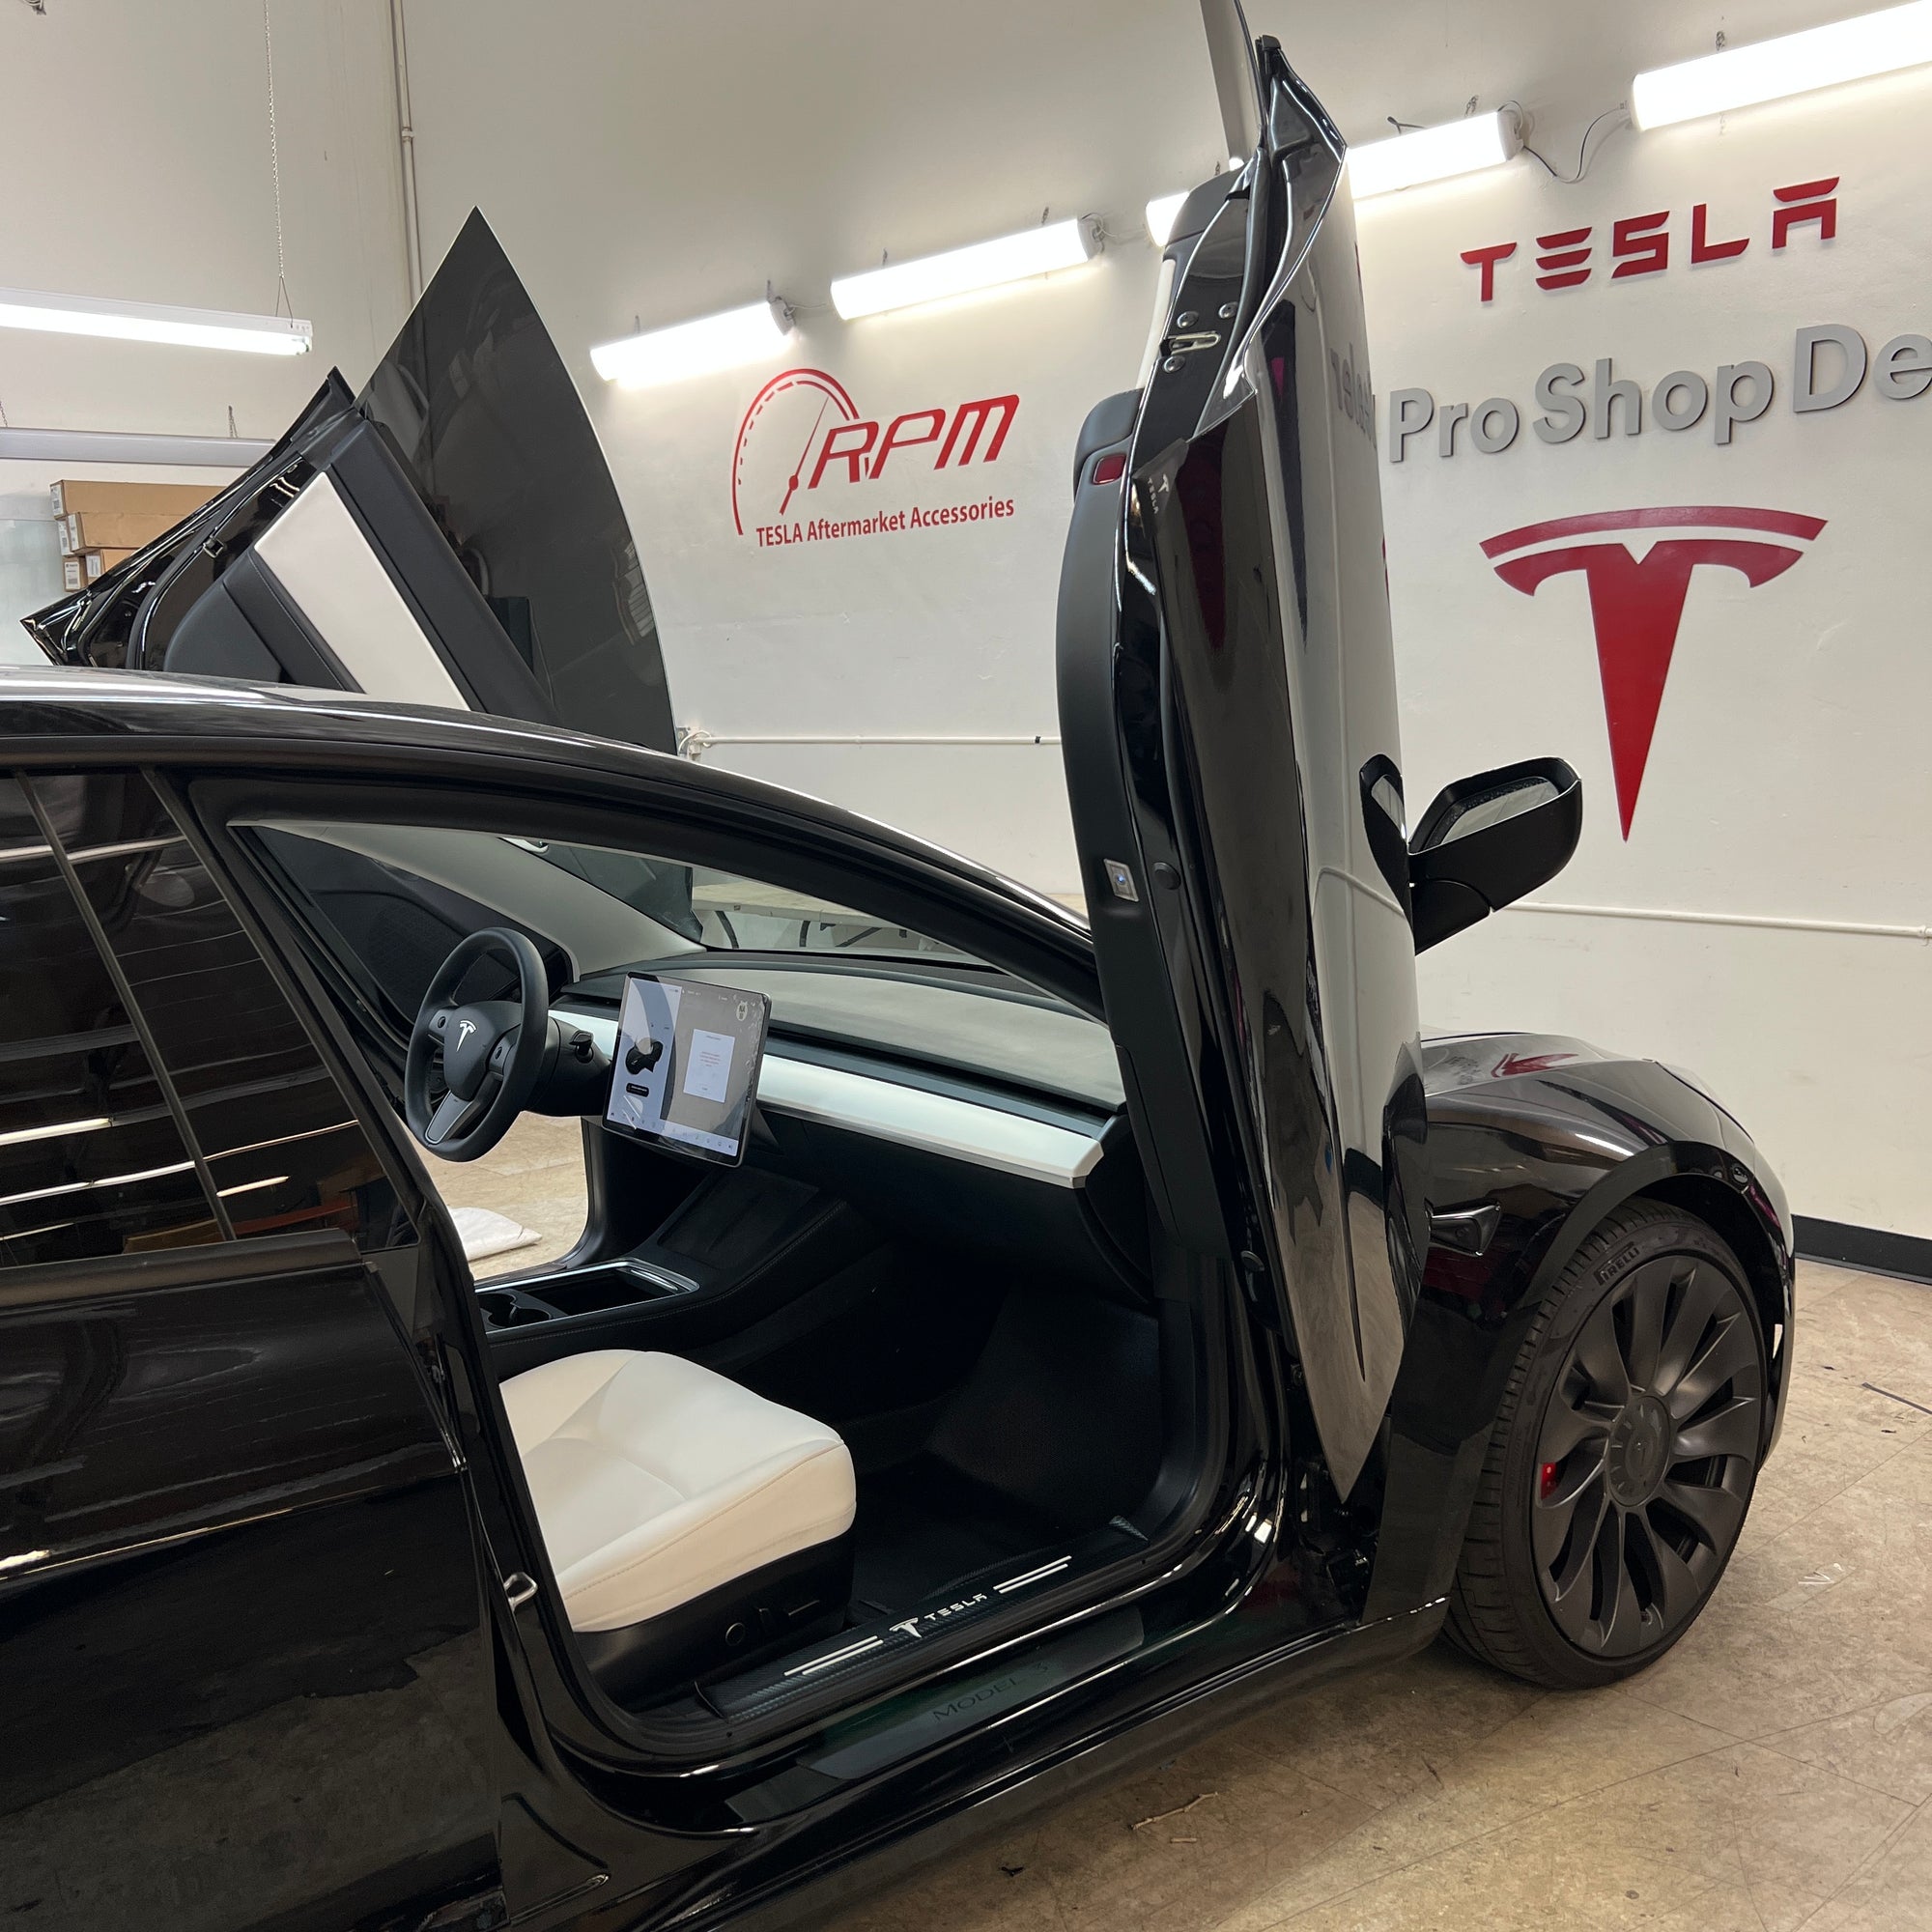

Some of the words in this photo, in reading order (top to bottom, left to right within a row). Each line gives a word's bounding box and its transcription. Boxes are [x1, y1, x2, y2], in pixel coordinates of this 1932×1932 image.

[1460, 176, 1839, 301] TESLA
[1389, 387, 1520, 463] Pro
[1532, 357, 1775, 445] Shop
[1793, 324, 1932, 413] De
[808, 393, 1020, 490] RPM
[756, 523, 803, 548] TESLA
[808, 509, 906, 542] Aftermarket
[910, 496, 1014, 529] Accessories
[1594, 1241, 1640, 1286] PIRELLI
[923, 1592, 988, 1622] TESLA
